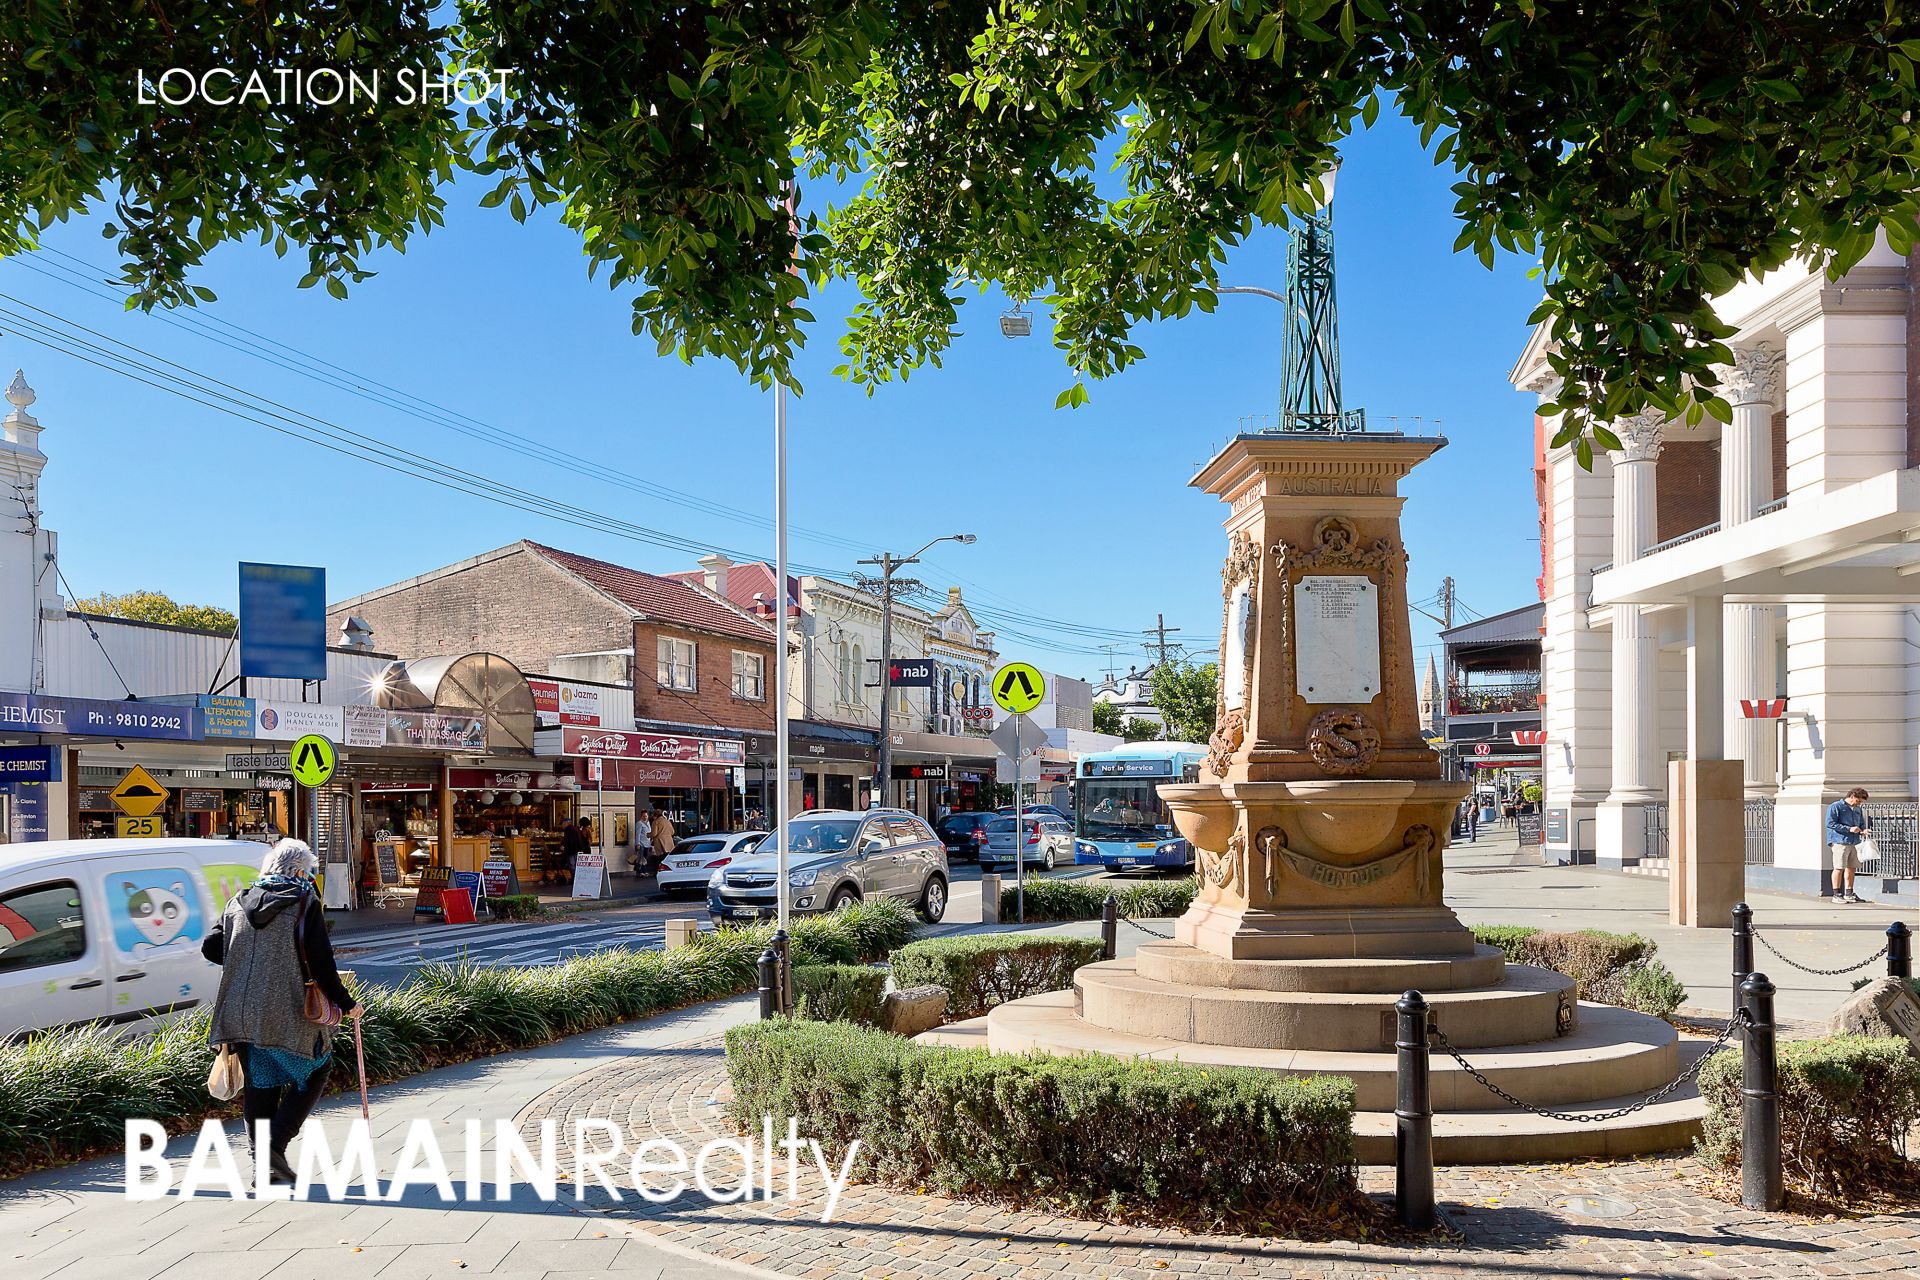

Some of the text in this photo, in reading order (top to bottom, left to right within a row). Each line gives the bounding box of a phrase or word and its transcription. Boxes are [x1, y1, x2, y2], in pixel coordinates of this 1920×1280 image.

[1280, 477, 1384, 495] AUSTRALIA
[902, 664, 930, 679] nab
[573, 688, 598, 700] Jazma
[211, 697, 245, 708] BALMAIN
[88, 711, 104, 725] Ph
[116, 713, 147, 727] 9810
[150, 715, 181, 730] 2942
[286, 710, 334, 720] DOUGLASS
[209, 717, 248, 728] & FASHION
[286, 718, 339, 728] HANLY MOIR
[424, 717, 451, 729] ROYAL
[406, 728, 468, 741] THAI MASSAGE
[892, 734, 904, 745] nab
[580, 735, 629, 754] Bakers Delight
[640, 739, 682, 758] Bakers Delight
[809, 744, 826, 755] maple
[7, 760, 47, 772] CHEMIST
[232, 755, 261, 767] taste
[640, 769, 673, 783] Bakers Delight
[923, 766, 944, 776] nab
[662, 810, 686, 823] SALE
[126, 819, 154, 835] 25
[421, 868, 450, 881] THAI
[1311, 863, 1384, 888] HONOUR
